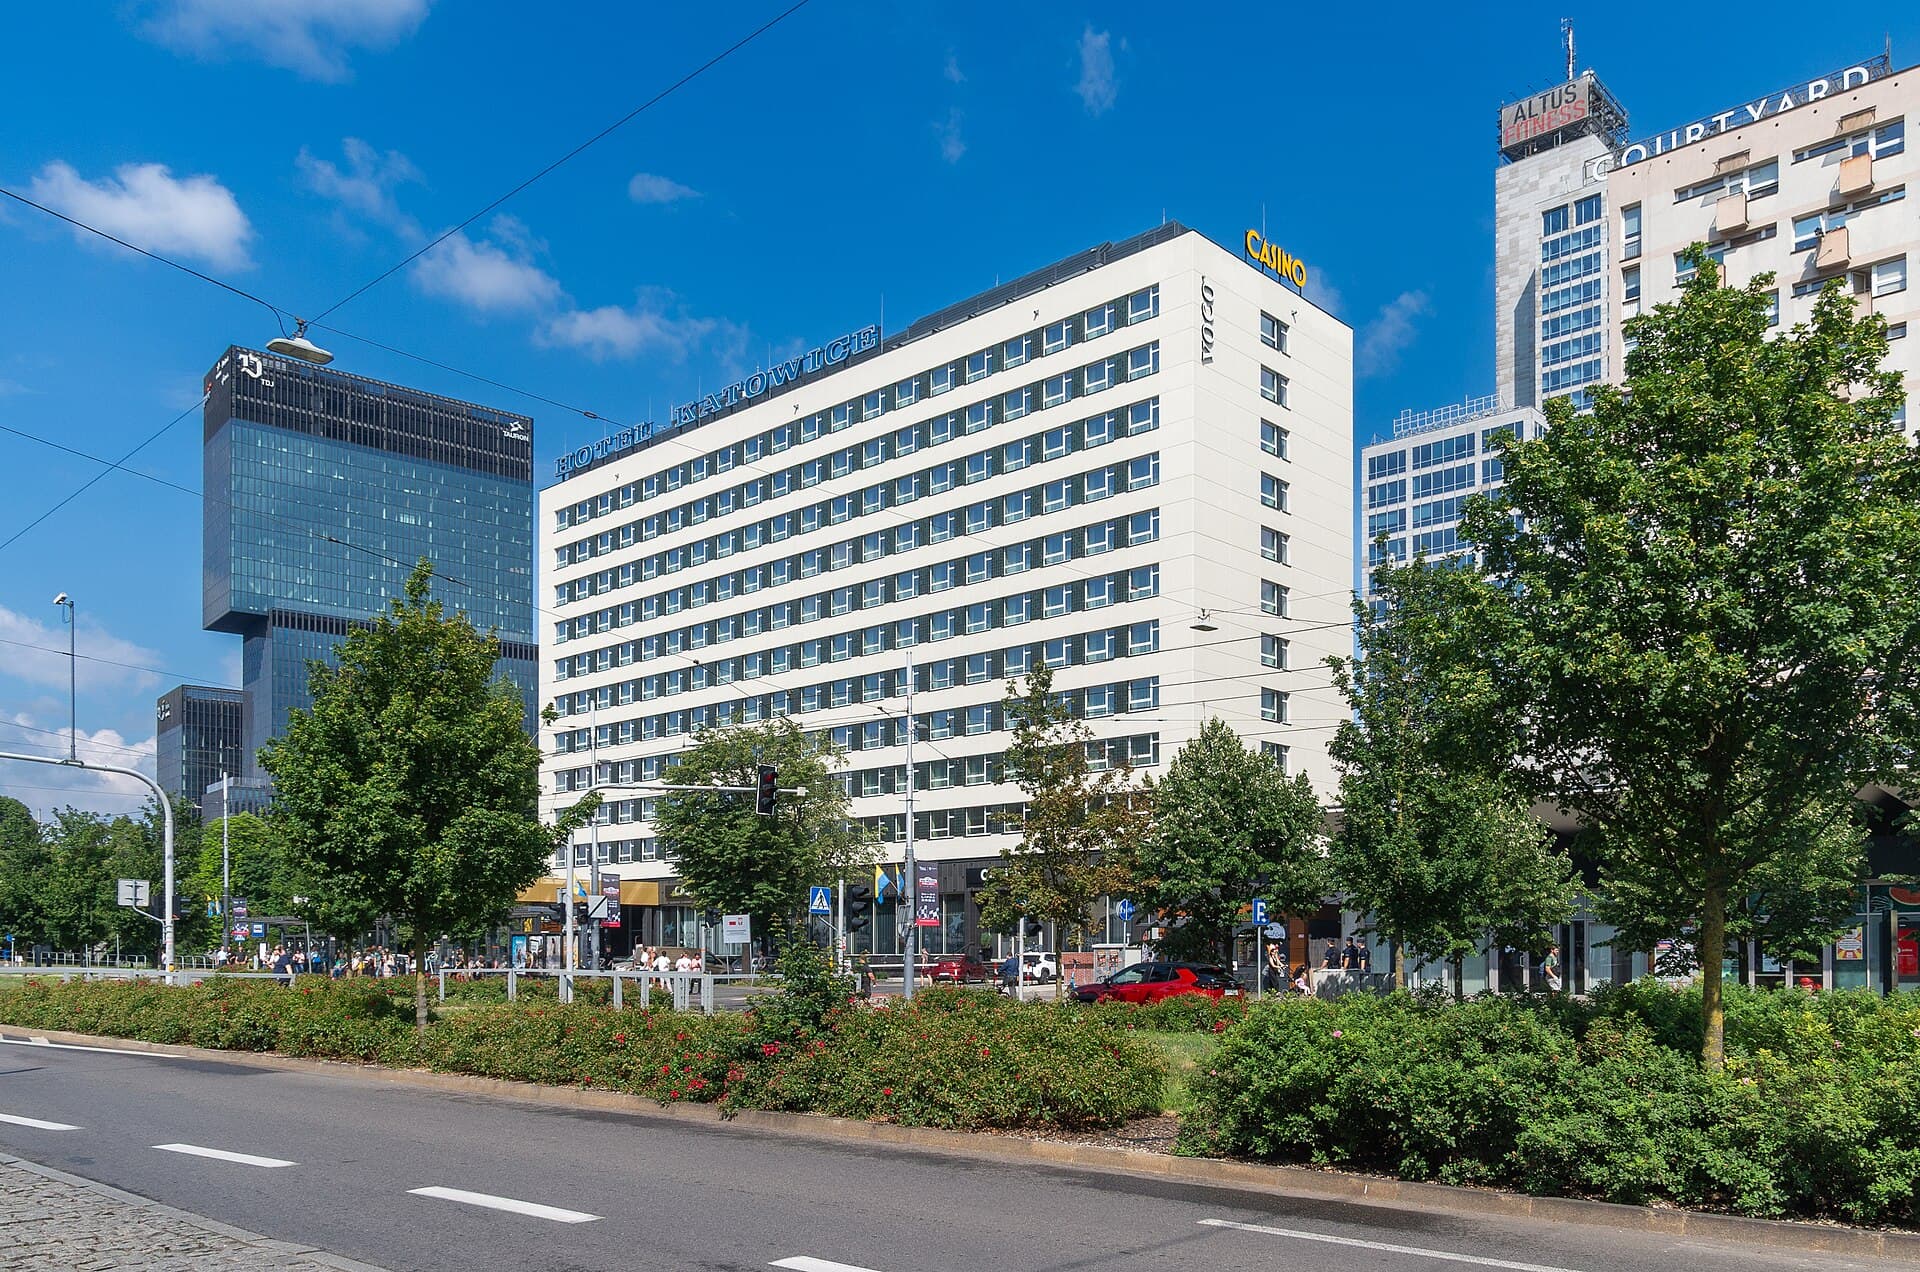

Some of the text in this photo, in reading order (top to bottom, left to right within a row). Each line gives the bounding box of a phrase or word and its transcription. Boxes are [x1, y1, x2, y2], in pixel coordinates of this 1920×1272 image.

[1504, 99, 1586, 145] FITNESS
[1514, 84, 1577, 124] ALTUS
[1593, 67, 1870, 181] COURTYARD
[1245, 229, 1307, 288] CASINO
[261, 378, 275, 388] TDJ
[554, 324, 879, 477] HOTEL KATOWICE
[502, 430, 529, 442] TAURON
